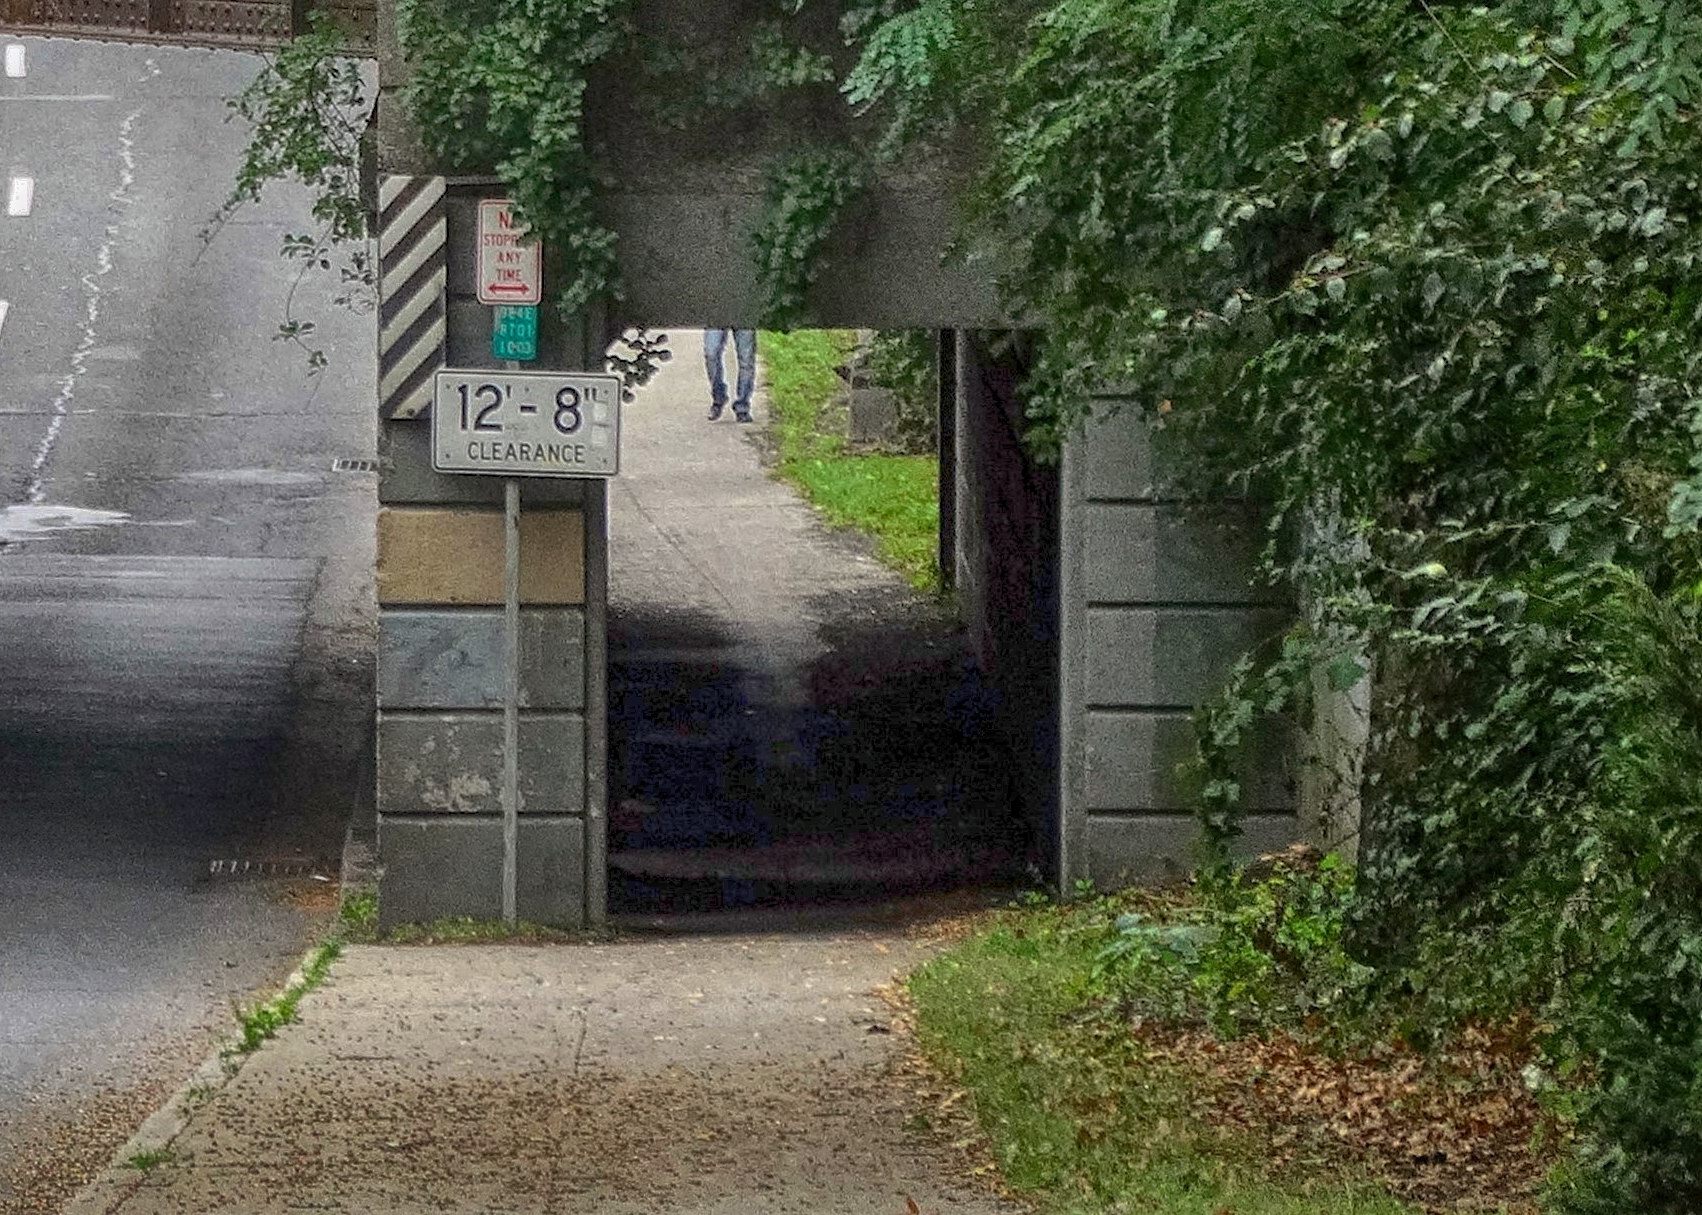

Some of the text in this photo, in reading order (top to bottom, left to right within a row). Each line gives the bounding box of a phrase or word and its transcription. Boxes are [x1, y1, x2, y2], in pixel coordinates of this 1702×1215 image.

[497, 251, 522, 264] ANY
[496, 269, 522, 282] TIME
[467, 441, 586, 463] CLEARANCE
